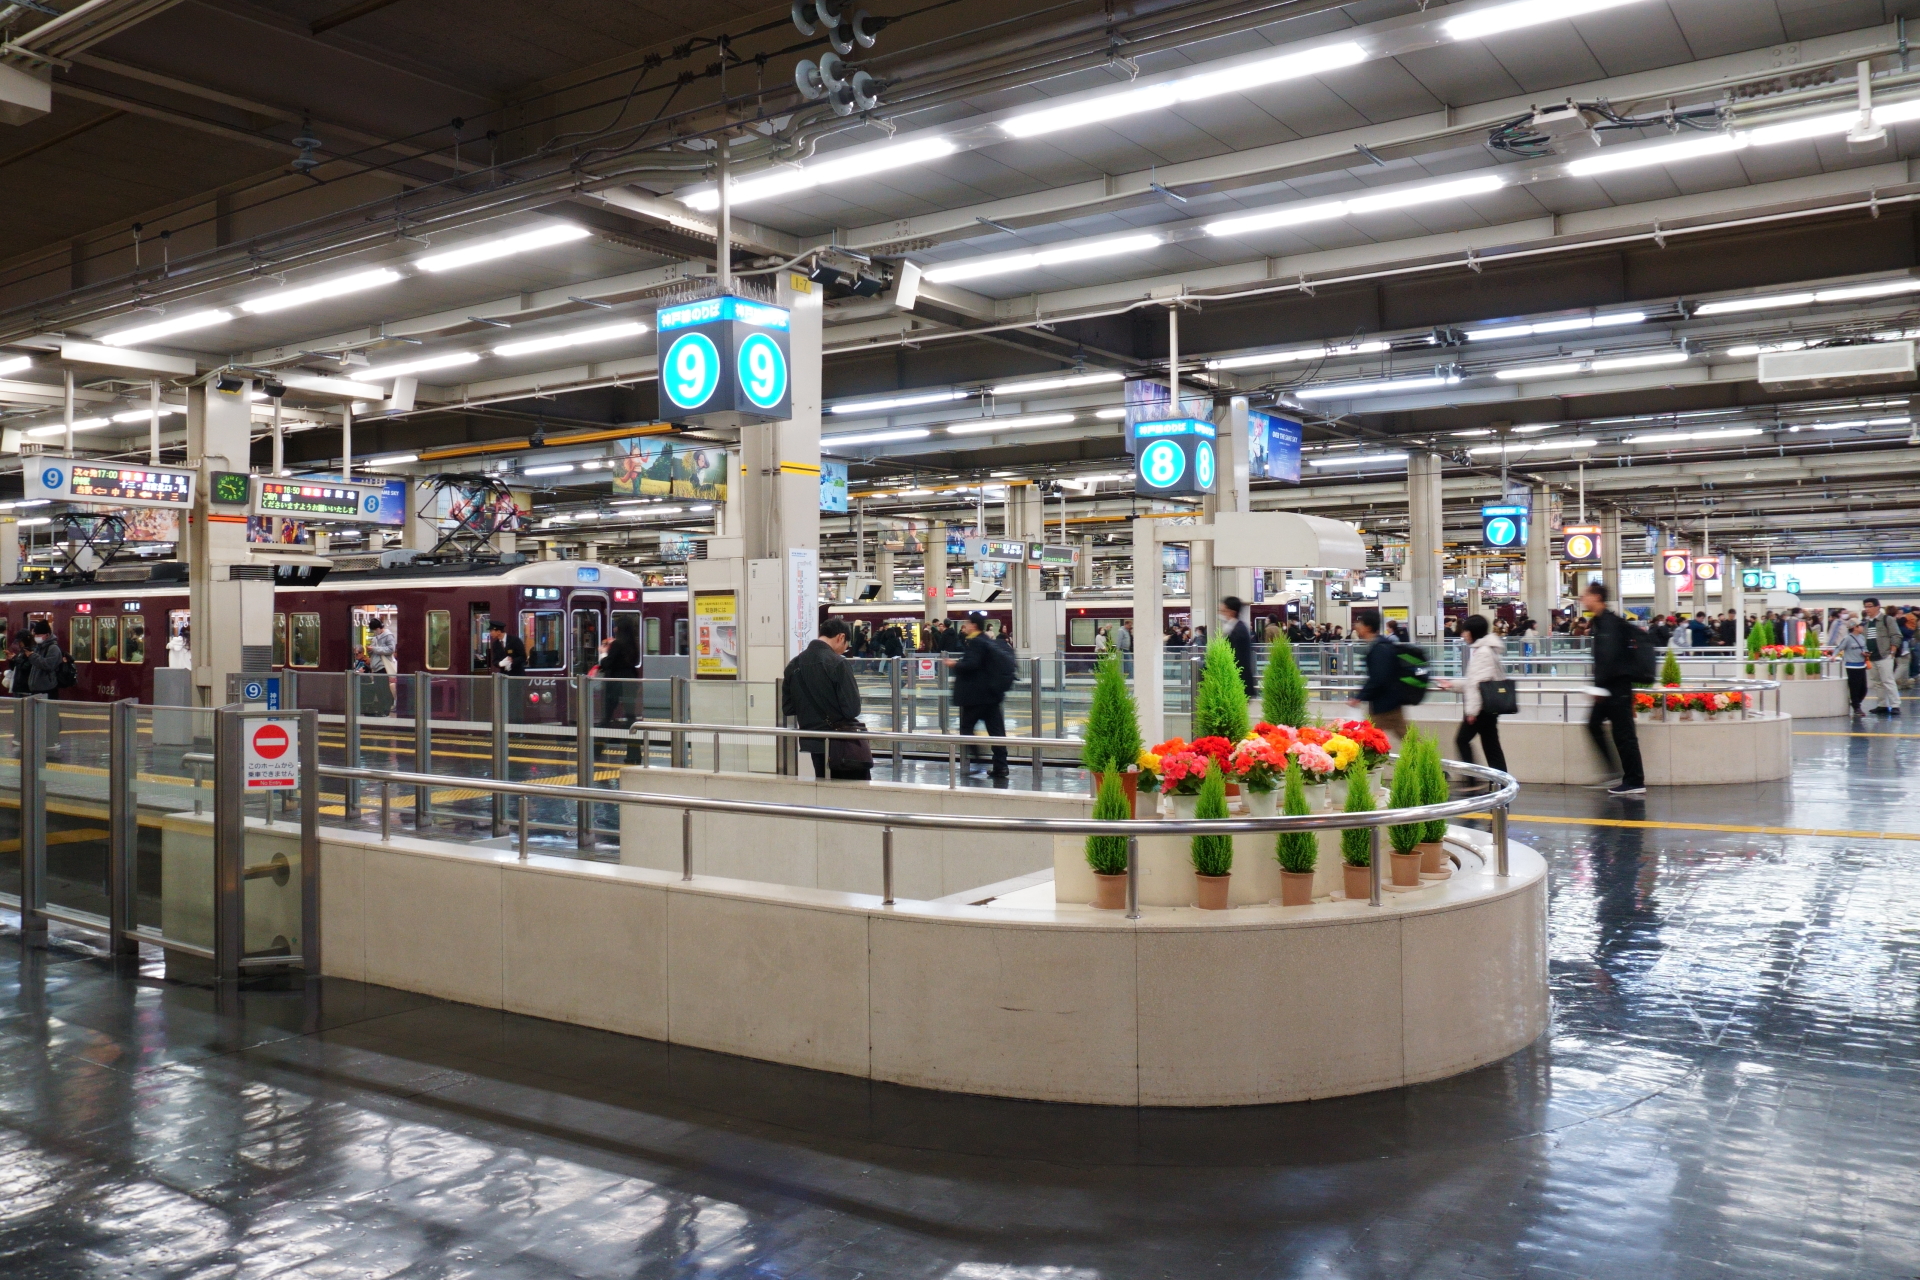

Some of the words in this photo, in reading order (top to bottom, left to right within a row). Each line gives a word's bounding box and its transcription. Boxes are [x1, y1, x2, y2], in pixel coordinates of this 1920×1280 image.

[677, 344, 705, 398] 9
[750, 344, 775, 398] 9
[1152, 446, 1175, 482] 8
[1200, 447, 1210, 482] 8
[47, 471, 58, 486] 9
[98, 470, 118, 479] 17:00
[284, 486, 300, 494] 16:50
[262, 500, 357, 514] くださいますようお願いいたしま
[367, 498, 376, 510] 8
[1494, 522, 1508, 541] 7
[982, 545, 987, 554] 7
[1573, 538, 1586, 556] 6
[1669, 559, 1680, 572] 5
[1700, 564, 1710, 576] 4
[1748, 574, 1755, 586] 3
[96, 685, 115, 694] 7022
[250, 685, 258, 697] 9
